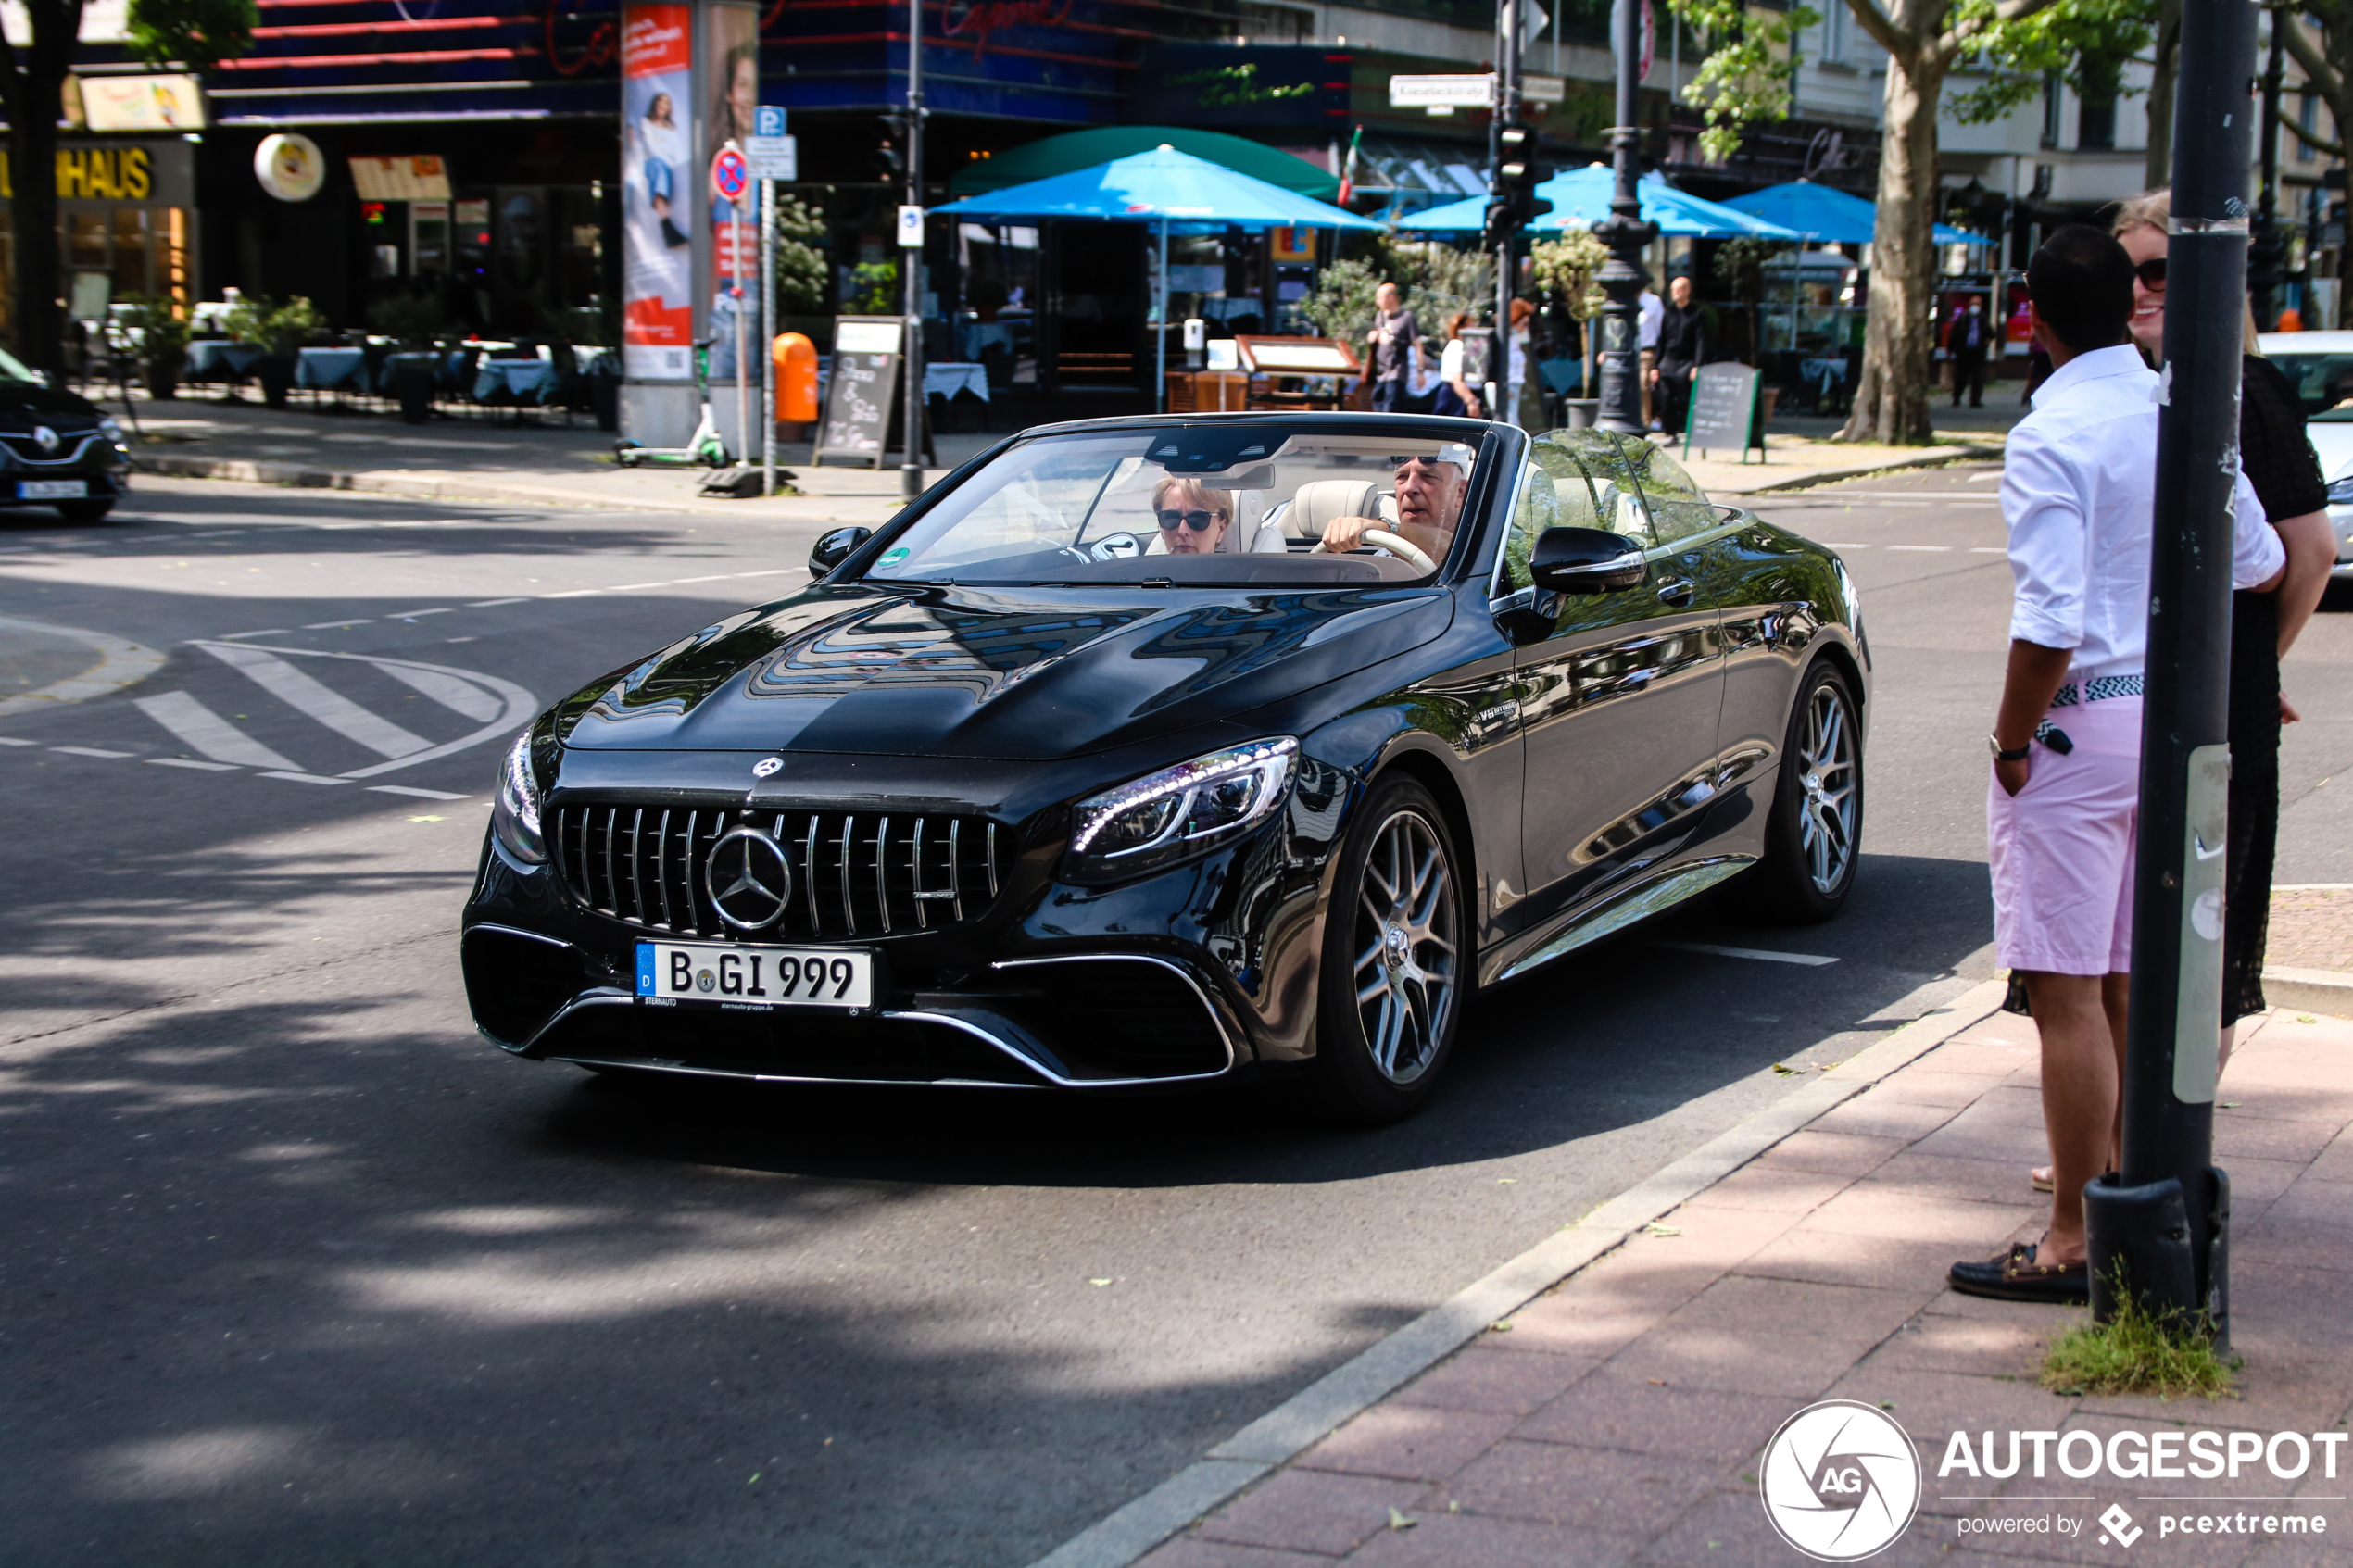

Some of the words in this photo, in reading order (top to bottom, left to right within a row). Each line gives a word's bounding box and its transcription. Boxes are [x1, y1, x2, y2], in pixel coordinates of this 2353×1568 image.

[760, 110, 780, 135] P
[1280, 226, 1308, 253] EC
[1479, 709, 1494, 721] V8
[670, 950, 693, 992] B
[719, 952, 766, 997] GI
[779, 955, 853, 999] 999
[642, 975, 650, 987] D
[645, 997, 677, 1007] STERNAUTO
[721, 1002, 774, 1011] sternauto-gruppe.de
